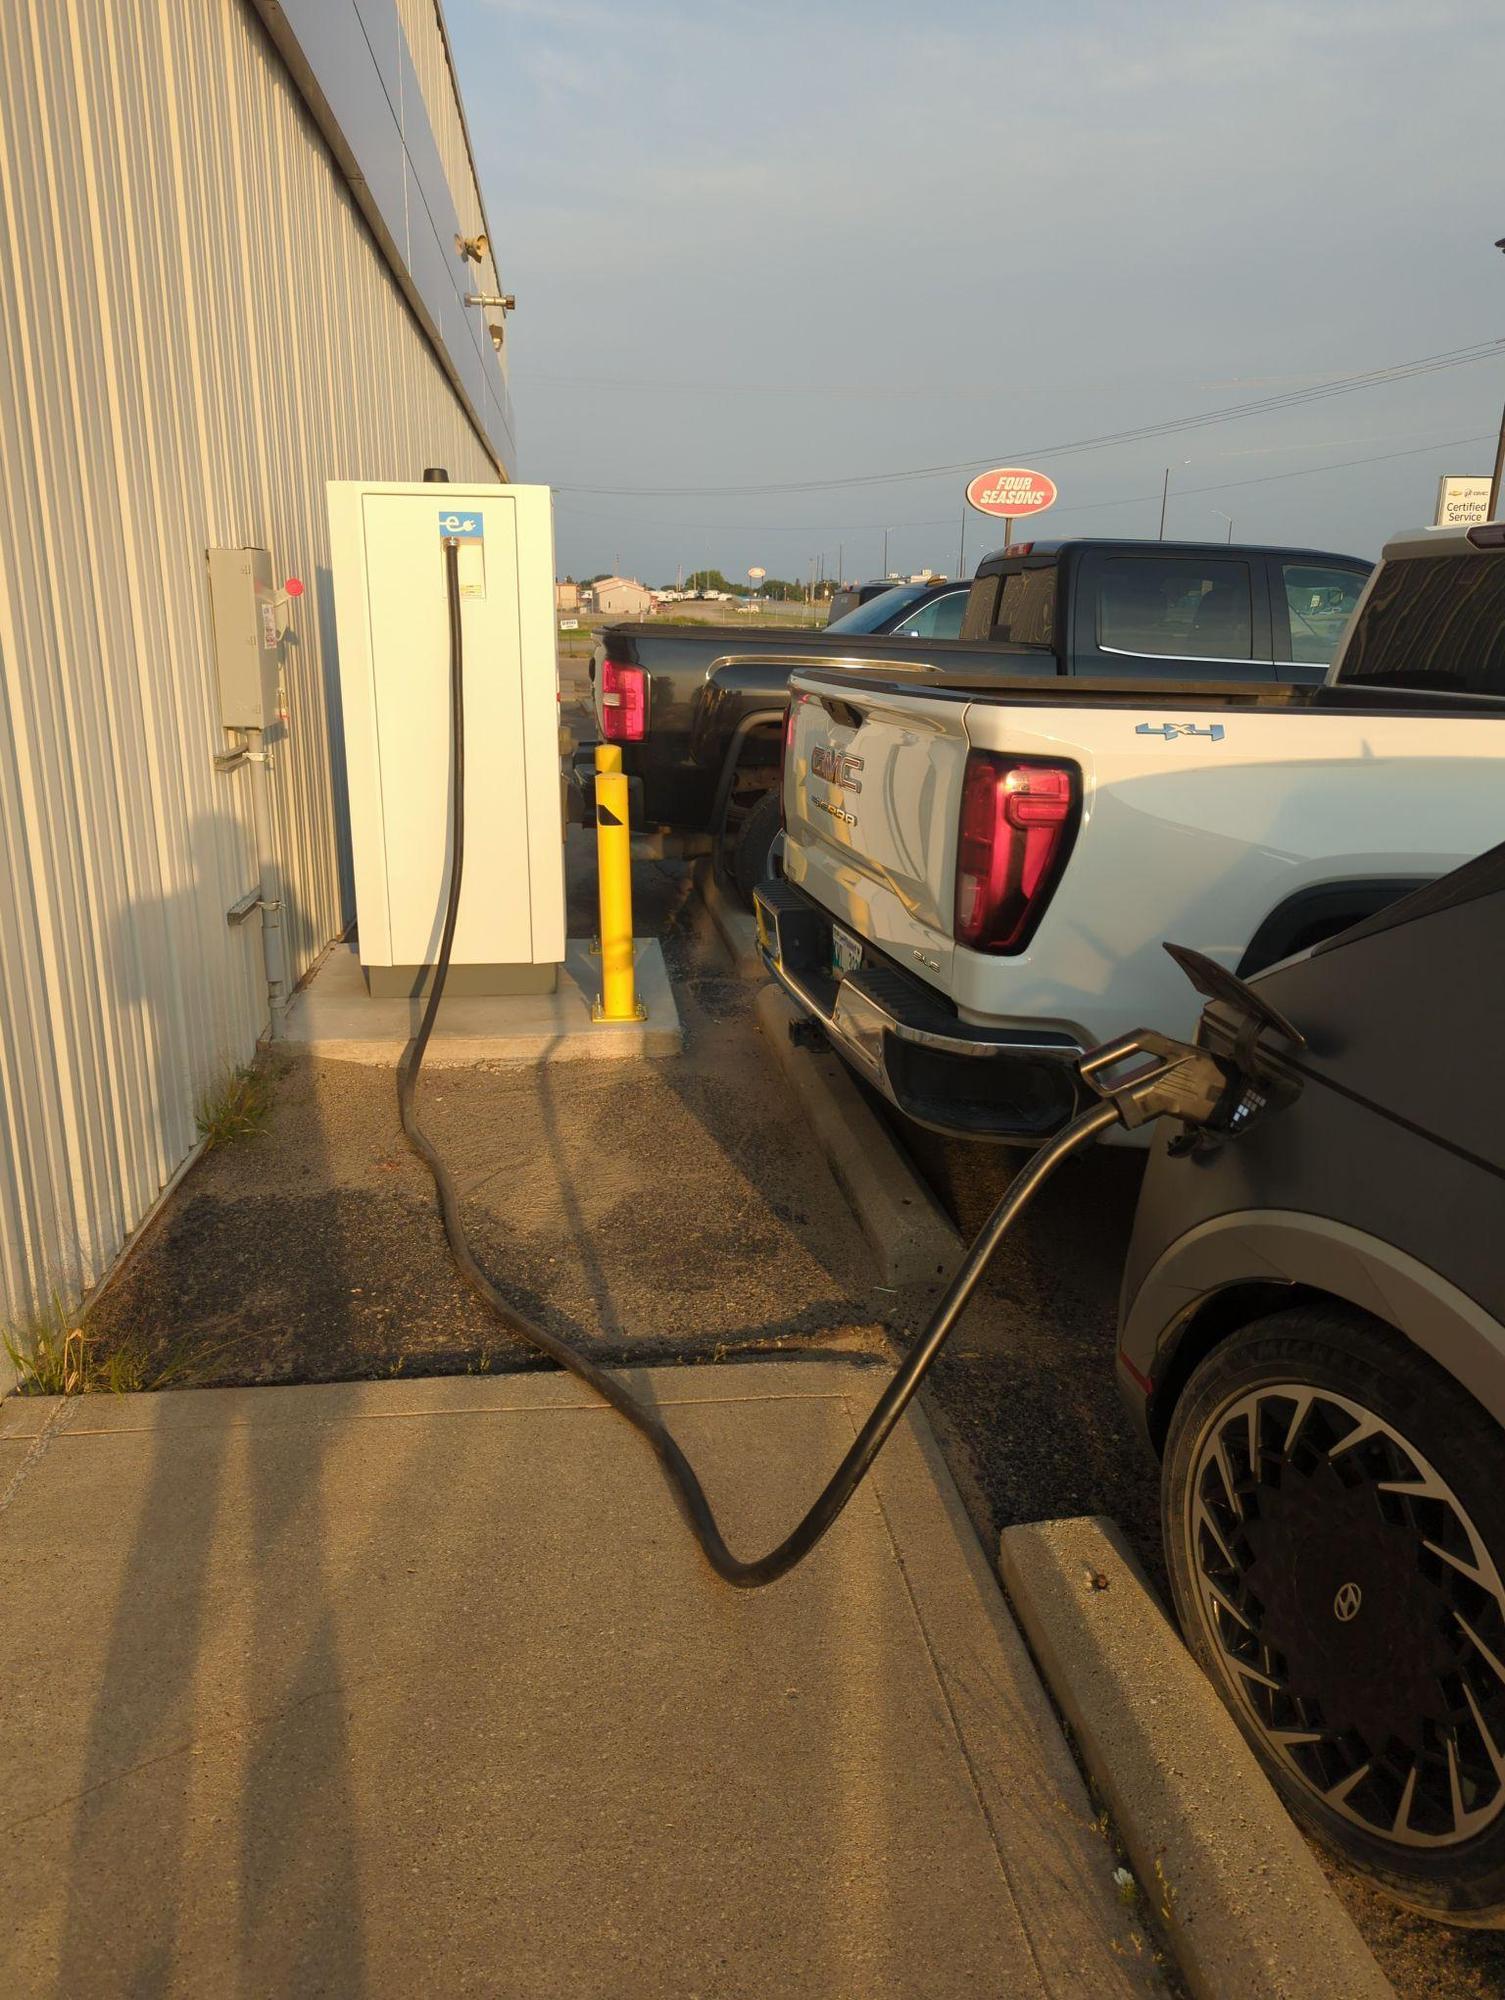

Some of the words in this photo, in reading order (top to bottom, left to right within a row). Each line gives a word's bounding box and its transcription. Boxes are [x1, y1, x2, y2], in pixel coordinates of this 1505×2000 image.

[996, 476, 1033, 491] FOUR
[980, 490, 1046, 505] SEASONS
[1446, 502, 1487, 512] Certified
[1448, 512, 1482, 522] Service
[812, 746, 864, 794] GMC
